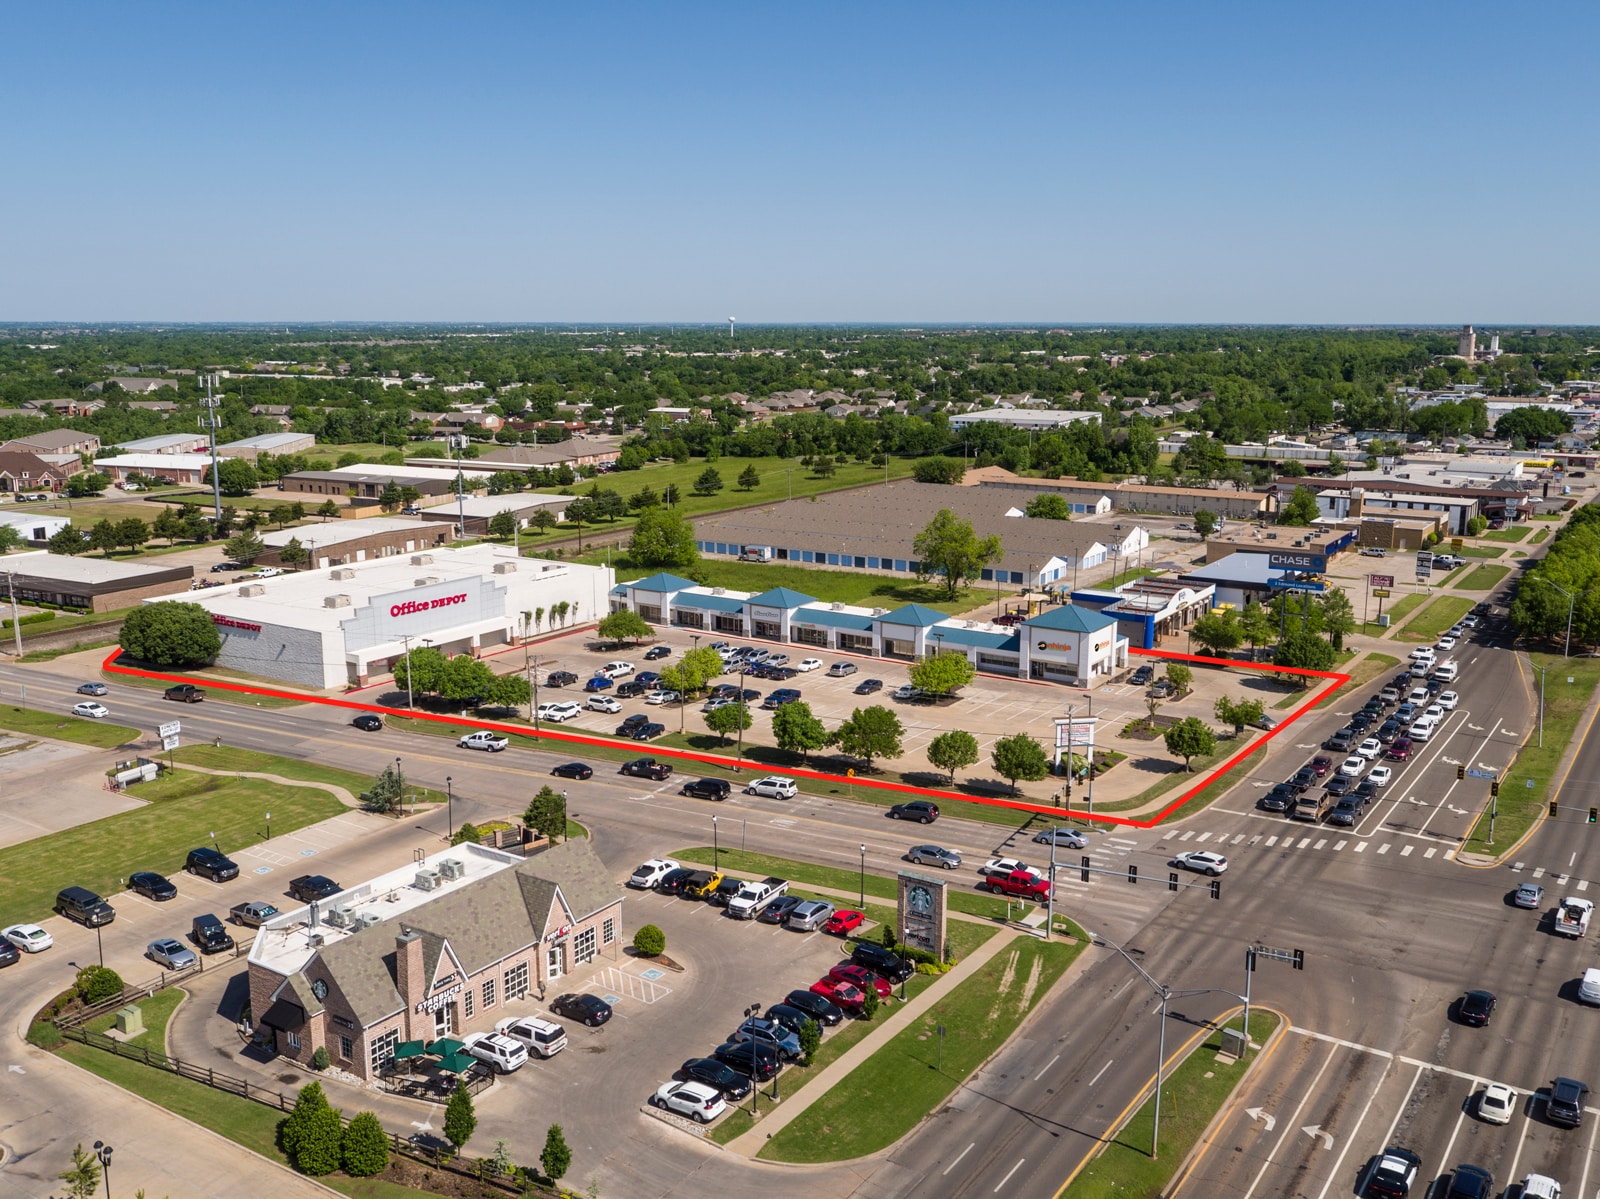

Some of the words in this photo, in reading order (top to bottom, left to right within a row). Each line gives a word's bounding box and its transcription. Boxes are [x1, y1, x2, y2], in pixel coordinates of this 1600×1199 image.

[1271, 554, 1311, 566] CHASE
[390, 601, 430, 617] Office
[430, 593, 467, 609] DEPOT
[235, 621, 262, 633] DEPOT
[416, 982, 465, 1013] STARBUCKS
[427, 994, 458, 1014] COFFEE
